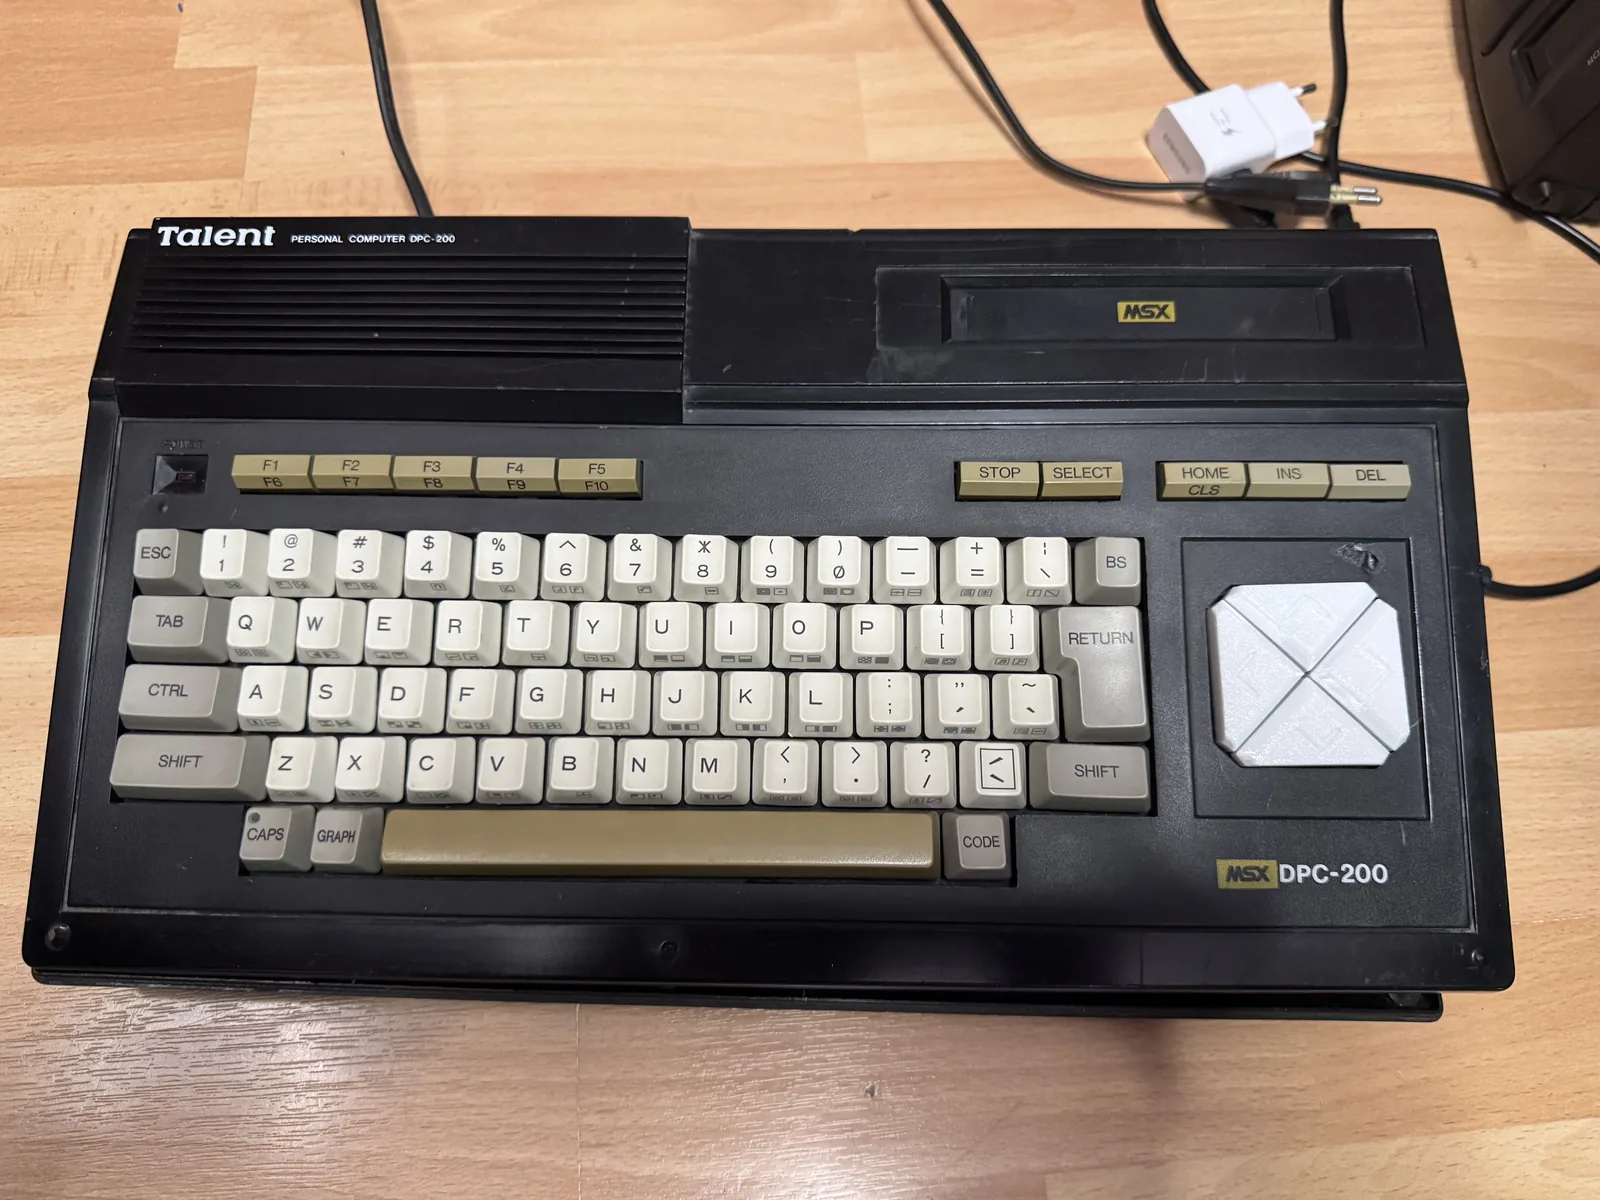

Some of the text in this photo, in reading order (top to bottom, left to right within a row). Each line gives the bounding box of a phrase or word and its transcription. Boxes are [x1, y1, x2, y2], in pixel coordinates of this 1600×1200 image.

[158, 226, 456, 246] Talent PERSONAL COMPUTER DPC-200
[1123, 305, 1170, 319] MSX
[263, 460, 278, 471] F1
[343, 460, 360, 471] F2
[424, 461, 440, 472] F3
[507, 463, 524, 473] F4
[589, 463, 605, 474] F5
[980, 467, 1020, 478] STOP
[1053, 467, 1112, 478] SELECT
[1182, 467, 1229, 479] HOME
[1277, 468, 1301, 479] INS
[1356, 469, 1386, 481] DEL
[263, 477, 282, 487] F6
[343, 477, 359, 486] F7
[424, 478, 443, 488] F8
[507, 480, 525, 489] F9
[585, 481, 608, 490] F10
[1189, 485, 1219, 495] CLS
[222, 534, 227, 548] !
[284, 534, 298, 548] @
[353, 536, 367, 548] #
[423, 535, 434, 550] $
[492, 538, 505, 551] %
[630, 538, 641, 551] &
[769, 538, 774, 555] (
[837, 539, 843, 556] )
[971, 542, 983, 554] +
[141, 546, 171, 559] ESC
[219, 559, 225, 573] 1
[283, 559, 294, 571] 2
[352, 560, 364, 573] 3
[421, 561, 433, 573] 4
[492, 562, 503, 575] 5
[1107, 556, 1126, 568] BS
[560, 563, 571, 576] 6
[630, 564, 641, 576] 7
[697, 565, 708, 577] 8
[766, 565, 776, 578] 9
[970, 568, 985, 577] =
[156, 615, 183, 627] TAB
[238, 615, 252, 630] Q
[939, 608, 944, 626] {
[1009, 608, 1014, 625] }
[307, 617, 323, 631] W
[377, 617, 391, 631] E
[449, 619, 461, 633] R
[517, 618, 530, 632] T
[587, 620, 599, 634] Y
[655, 620, 668, 634] U
[792, 620, 805, 634] O
[861, 621, 873, 635] P
[940, 633, 945, 650] [
[1009, 633, 1015, 650] ]
[1069, 632, 1133, 645] RETURN
[149, 684, 188, 697] CTRL
[249, 684, 262, 699] A
[319, 684, 332, 699] S
[391, 686, 405, 701] D
[460, 687, 474, 701] F
[530, 687, 543, 702] G
[601, 688, 614, 702] H
[668, 689, 681, 703] J
[740, 689, 752, 703] K
[809, 690, 822, 705] L
[159, 755, 203, 767] SHIFT
[780, 745, 790, 764] <
[851, 746, 861, 764] >
[921, 749, 930, 762] ?
[278, 756, 293, 771] Z
[347, 755, 362, 770] X
[419, 756, 433, 771] C
[491, 756, 504, 771] V
[562, 756, 576, 770] B
[632, 758, 646, 772] N
[701, 758, 717, 773] M
[1075, 765, 1119, 778] SHIFT
[922, 774, 932, 789] /
[247, 828, 284, 840] CAPS
[317, 830, 356, 843] GRAPH
[963, 836, 1000, 848] CODE
[1226, 864, 1388, 883] MSX DPC-200
